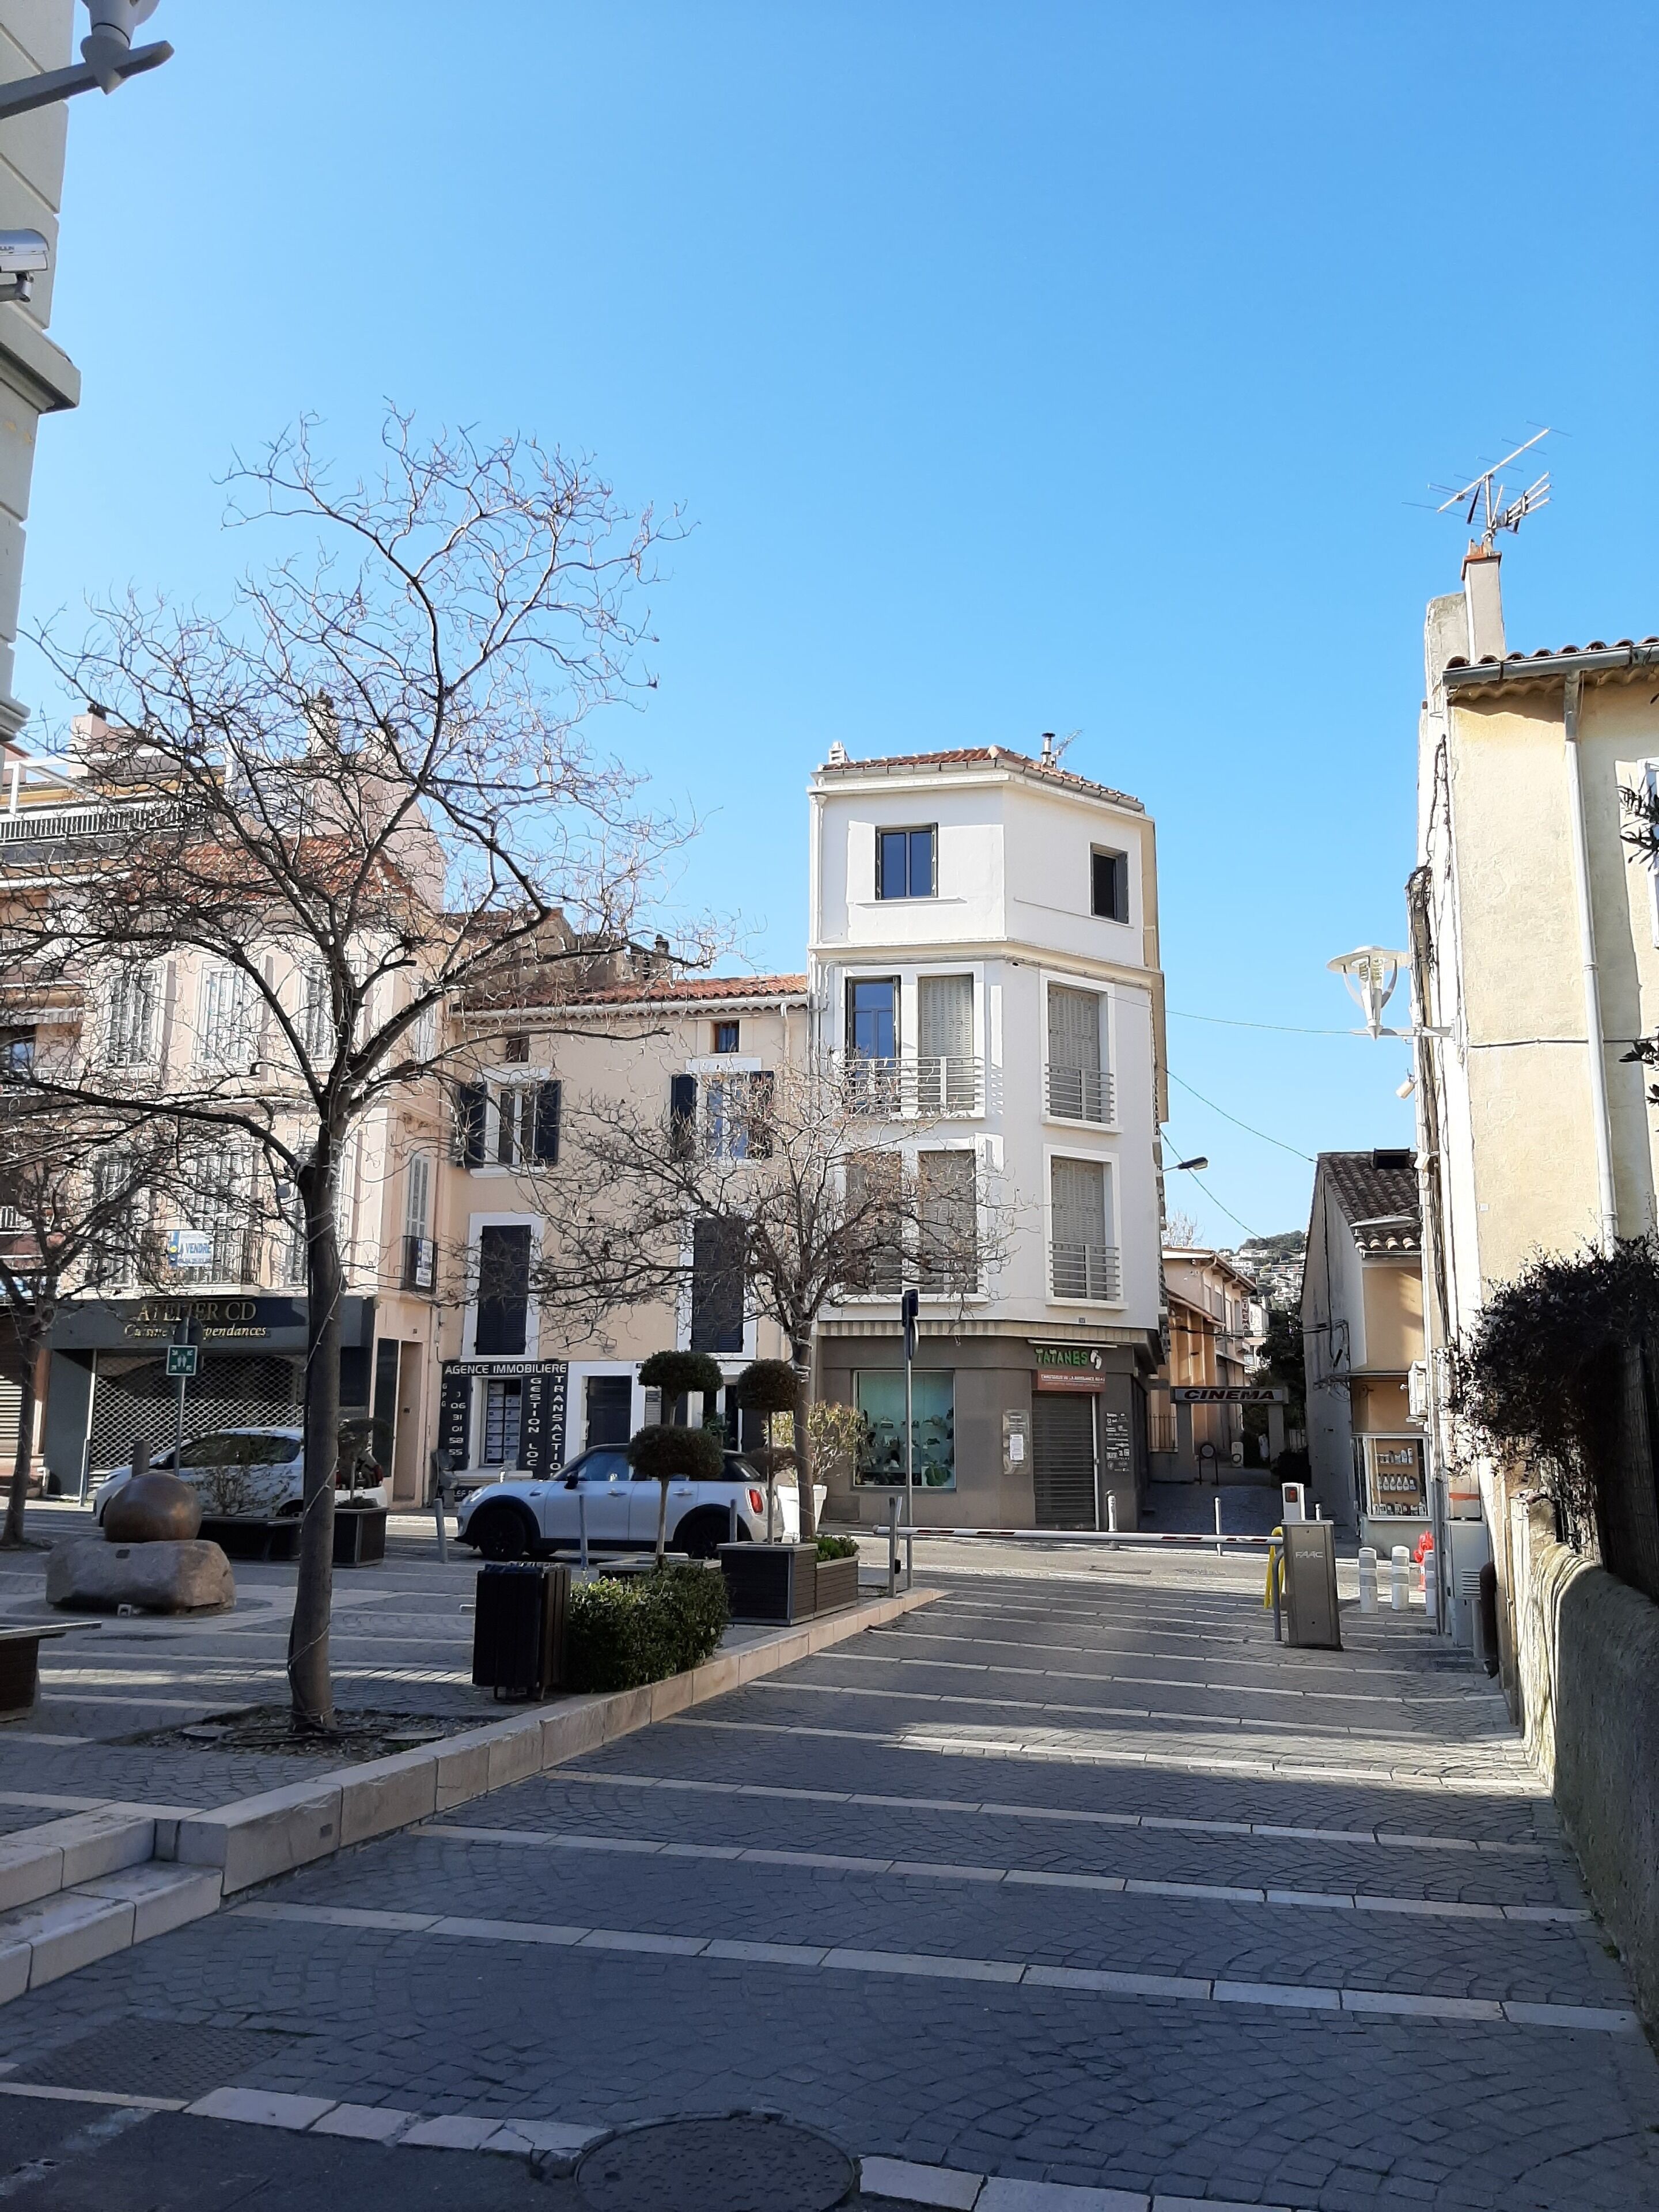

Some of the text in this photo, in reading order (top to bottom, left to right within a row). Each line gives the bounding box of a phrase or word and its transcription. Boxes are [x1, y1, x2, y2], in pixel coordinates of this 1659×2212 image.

[186, 1243, 211, 1253] VENDRE
[225, 1302, 256, 1321] CD
[1035, 1348, 1088, 1366] TATANES
[445, 1363, 567, 1374] AGENCE IMMOBILIERE
[1184, 1389, 1275, 1400] CINEMA
[526, 1377, 542, 1467] GESTION LOC
[550, 1376, 565, 1477] TRANSACTIO
